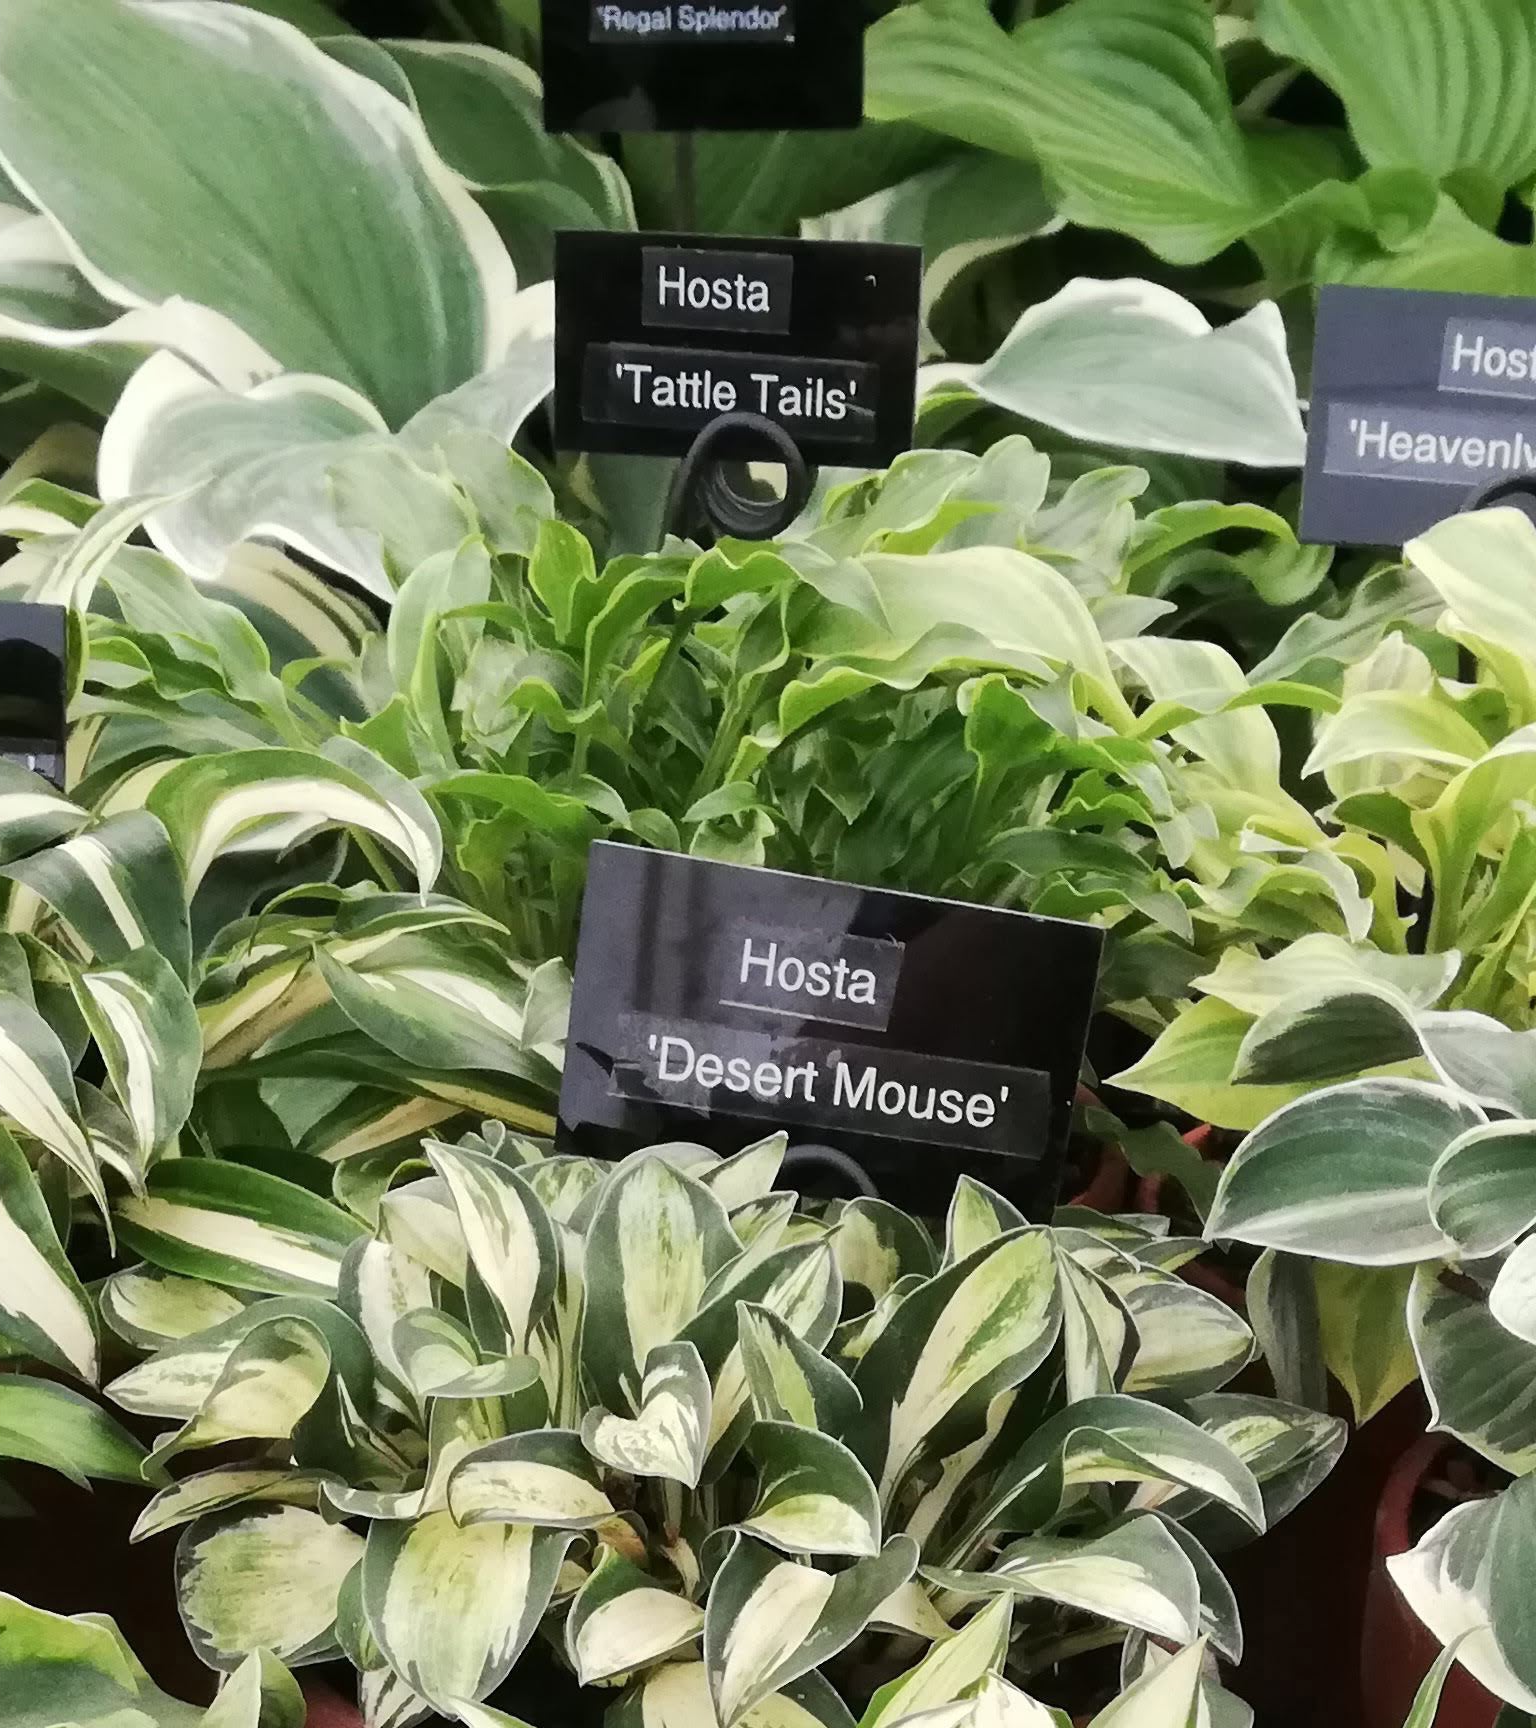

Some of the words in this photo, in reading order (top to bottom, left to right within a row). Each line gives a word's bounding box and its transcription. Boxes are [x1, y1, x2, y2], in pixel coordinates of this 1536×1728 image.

[658, 266, 770, 312] Hosta
[615, 363, 736, 410] 'Tattle
[751, 373, 858, 420] Tails'
[740, 938, 877, 1005] Hosta
[648, 1033, 819, 1104] 'Desert
[833, 1062, 1009, 1129] Mouse'
